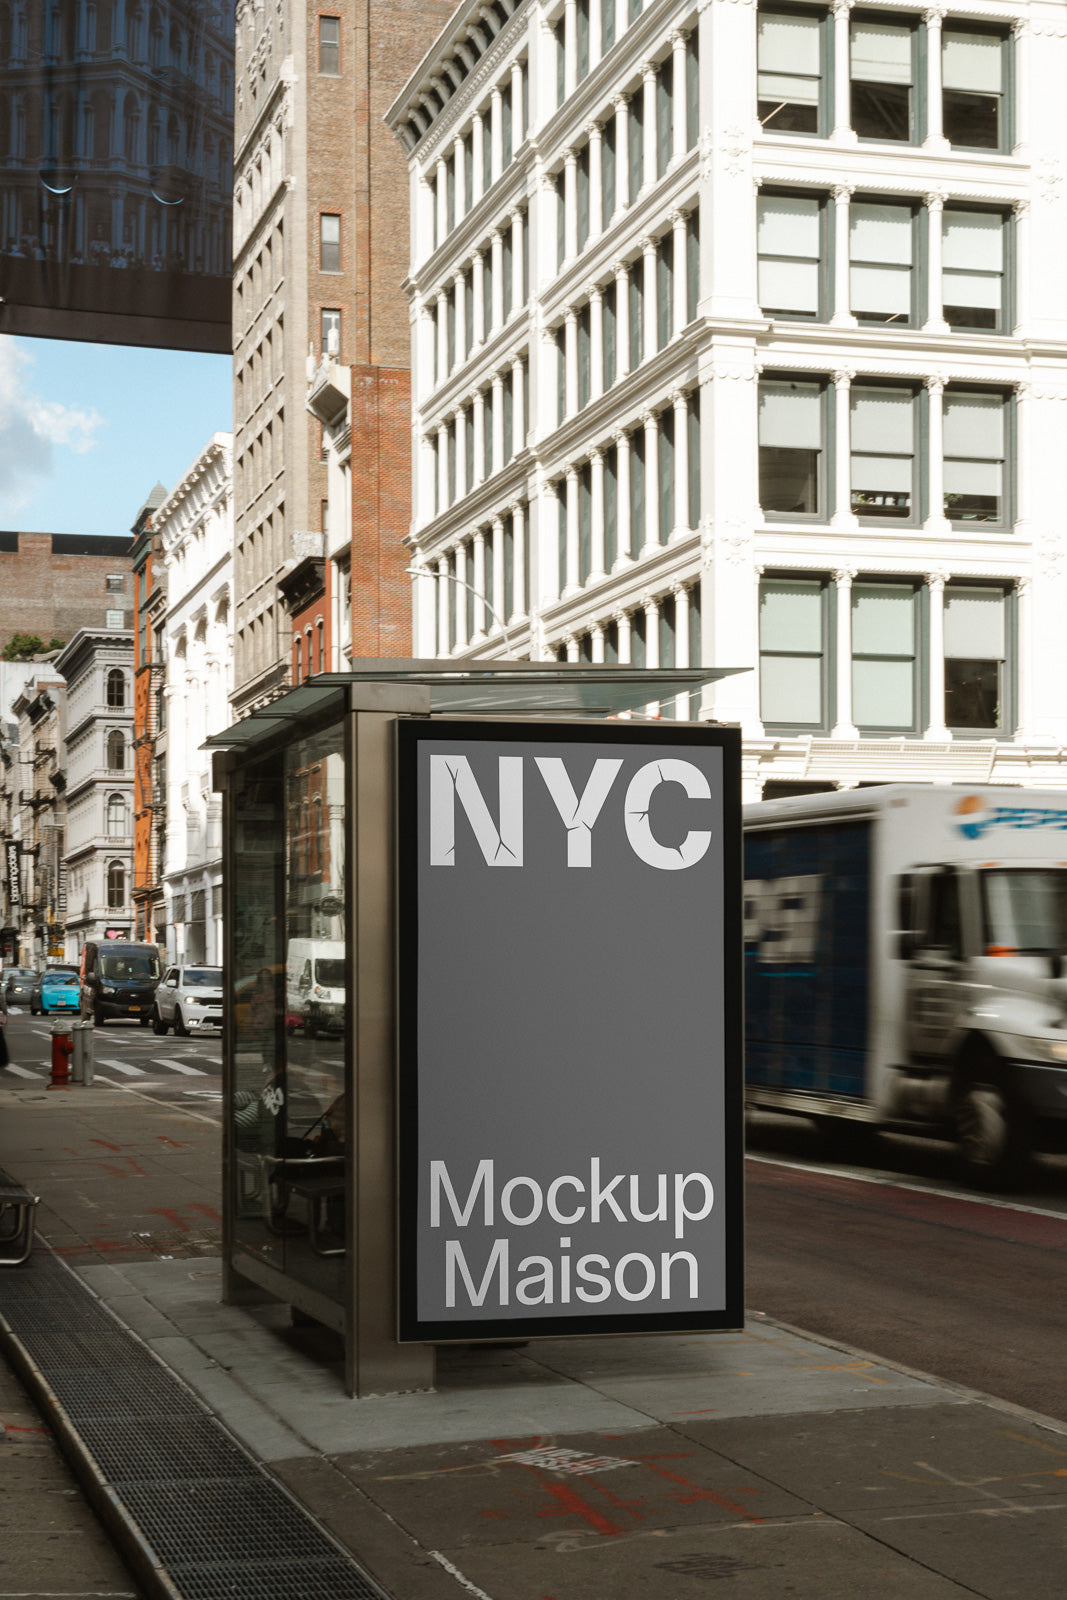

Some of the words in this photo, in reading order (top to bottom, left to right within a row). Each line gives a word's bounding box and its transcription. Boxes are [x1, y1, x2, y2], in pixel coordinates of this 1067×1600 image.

[430, 754, 712, 870] NYC
[430, 1157, 714, 1239] Mockup
[446, 1237, 699, 1308] Maison
